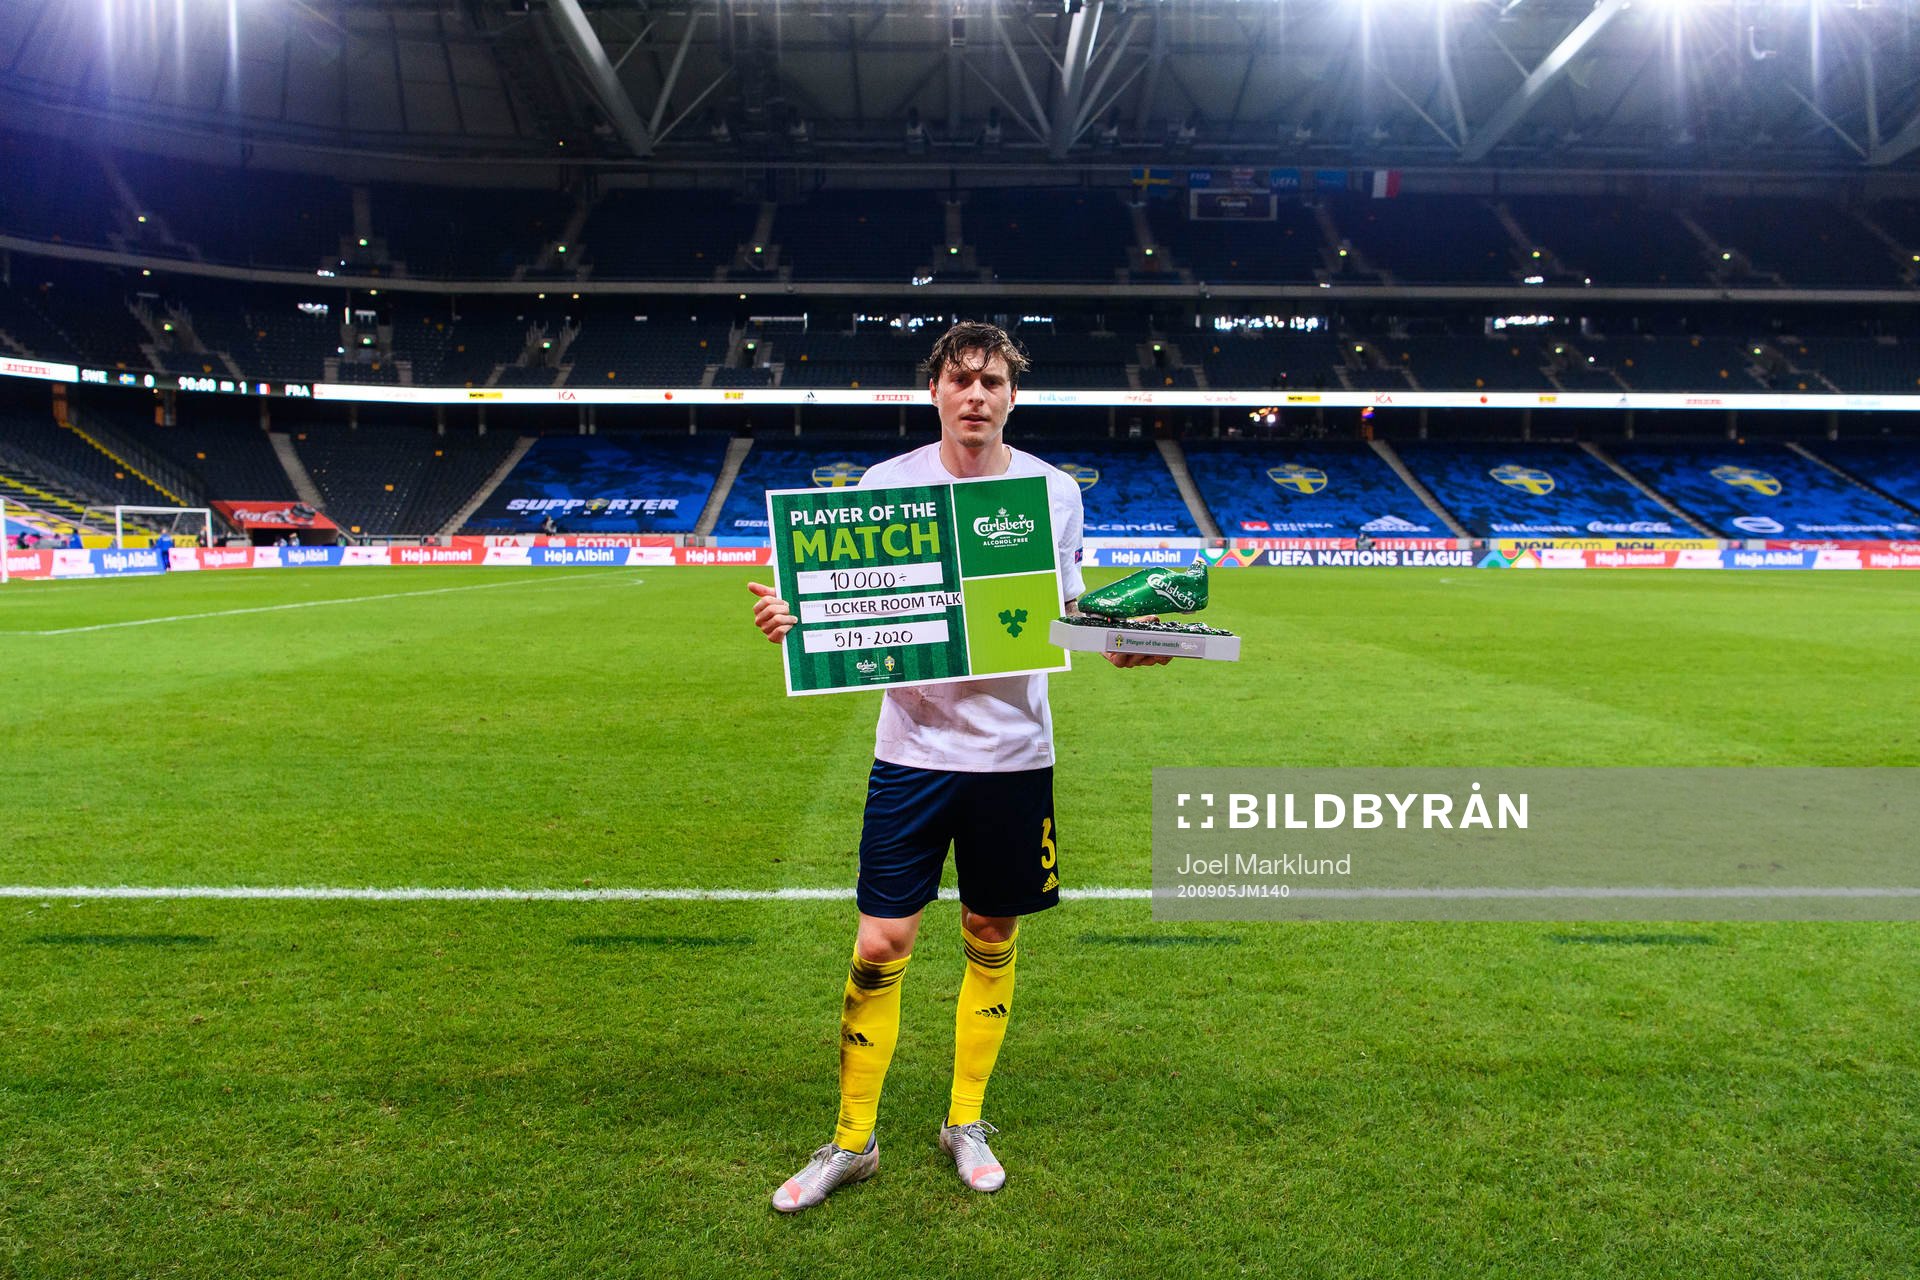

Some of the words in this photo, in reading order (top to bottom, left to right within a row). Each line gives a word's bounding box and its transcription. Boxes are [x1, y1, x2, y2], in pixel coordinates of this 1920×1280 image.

[81, 369, 108, 384] SWE
[144, 374, 155, 388] 0
[239, 381, 247, 394] 1
[285, 384, 312, 397] FRA
[559, 391, 576, 400] ICA
[790, 508, 864, 526] PLAYER
[868, 504, 895, 521] OF
[900, 502, 937, 519] THE
[973, 515, 1034, 537] Carlsberg
[1083, 523, 1177, 532] Scandic
[792, 521, 941, 564] MATCH
[983, 538, 1013, 546] ALCOHOL
[401, 549, 431, 564] Heja
[544, 549, 575, 565] Heja
[686, 550, 715, 565] Heja
[1111, 550, 1141, 566] Heja
[1268, 551, 1314, 566] UEFA
[1324, 551, 1398, 566] NATIONS
[1402, 551, 1473, 566] LEAGUE
[1147, 573, 1196, 610] Carlsberg
[824, 599, 877, 615] LOCKER
[881, 596, 925, 611] ROOM
[928, 593, 962, 607] TALK
[1126, 638, 1144, 646] Player
